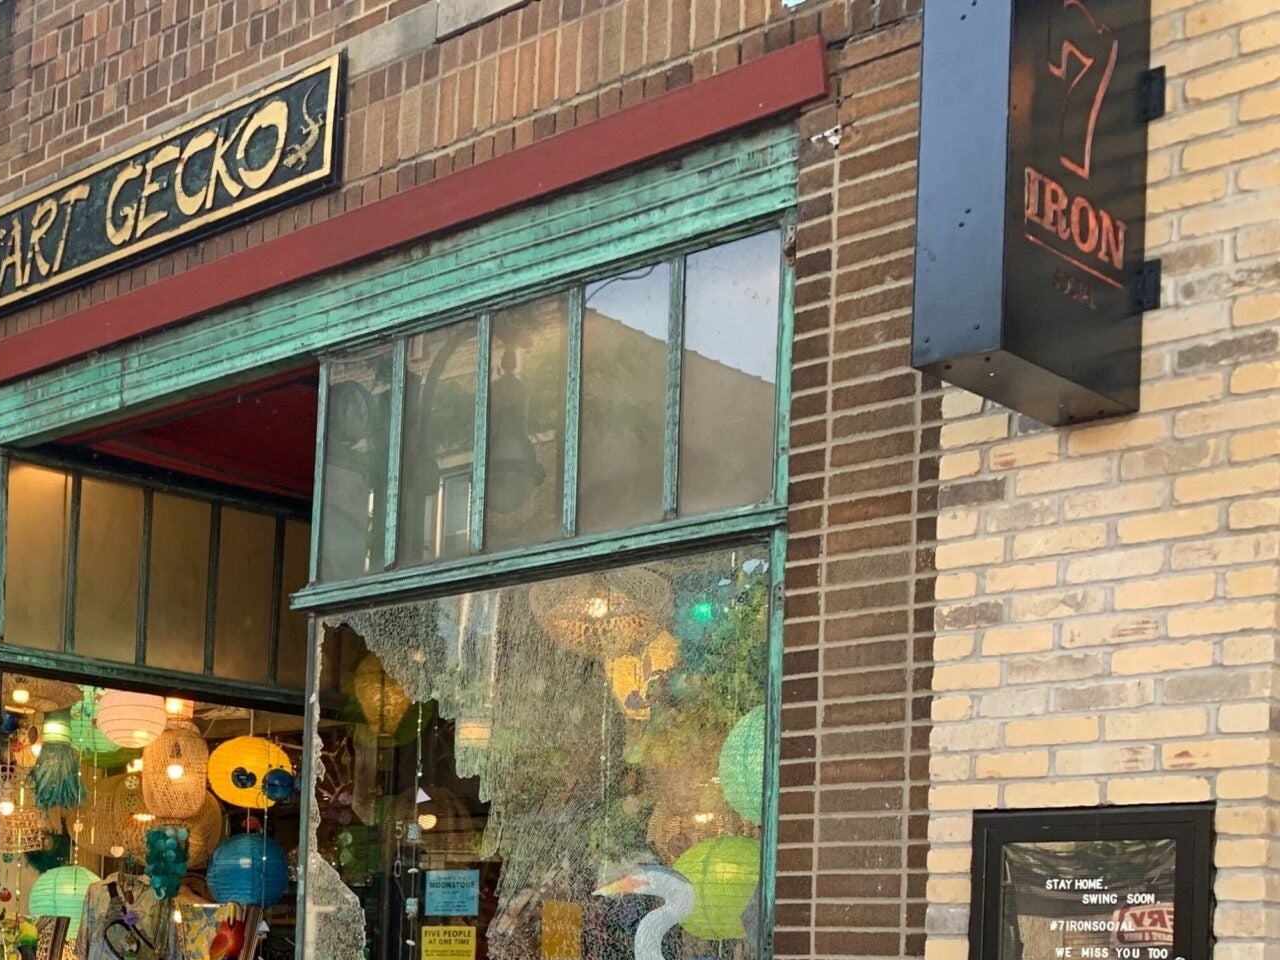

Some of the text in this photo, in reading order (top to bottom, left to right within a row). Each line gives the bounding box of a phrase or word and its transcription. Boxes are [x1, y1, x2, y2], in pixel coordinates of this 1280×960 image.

[105, 99, 290, 246] GECKO
[1024, 166, 1127, 270] IRON
[1045, 878, 1109, 890] STAY HOME.
[1082, 893, 1161, 905] SWING SOON.
[1049, 920, 1136, 932] #7IRONSOCIAL
[424, 930, 472, 938] FIVE PEOPLE
[1055, 947, 1169, 959] WE MISS YOU TOO
